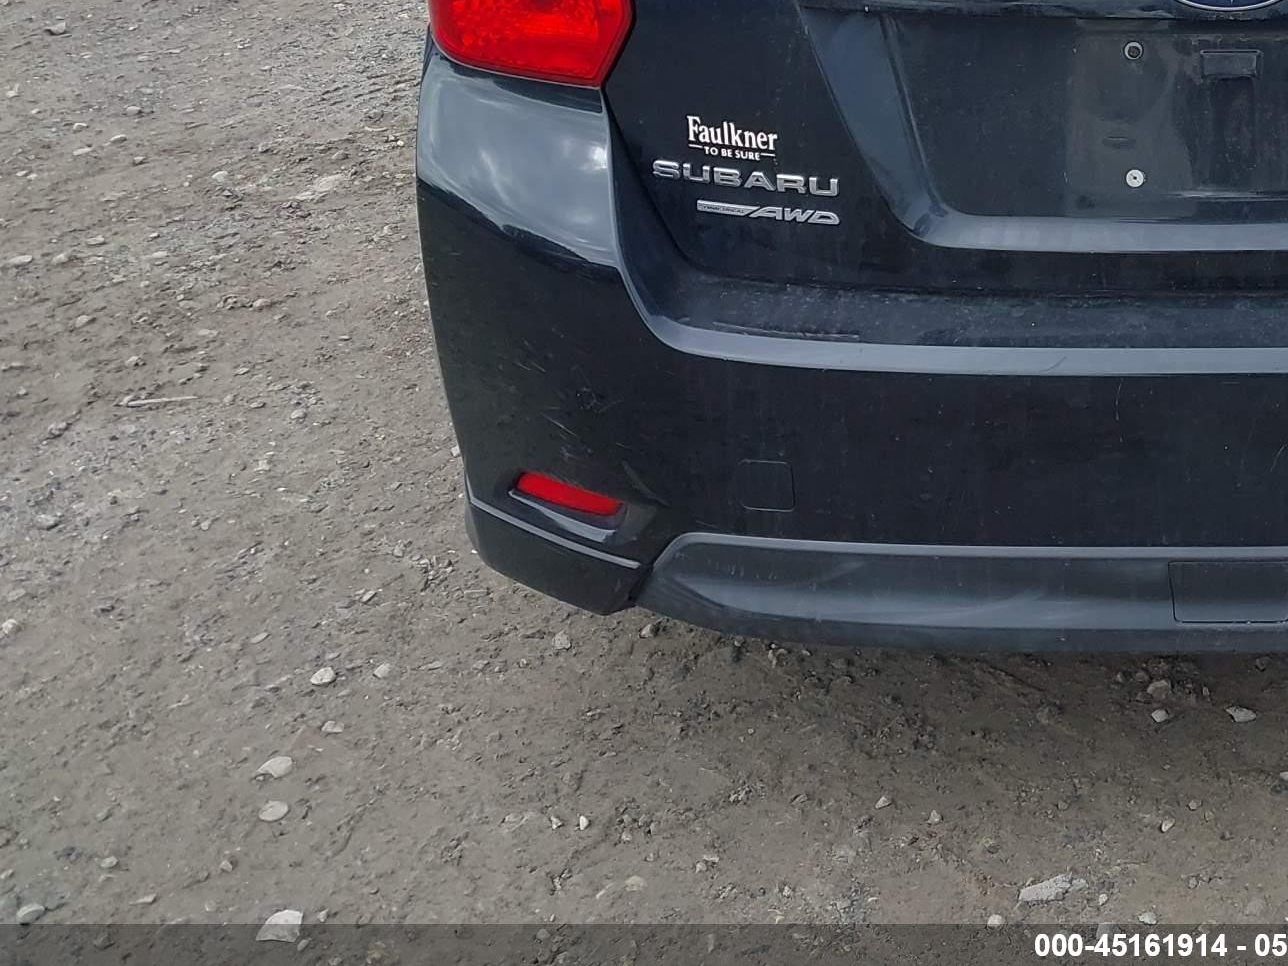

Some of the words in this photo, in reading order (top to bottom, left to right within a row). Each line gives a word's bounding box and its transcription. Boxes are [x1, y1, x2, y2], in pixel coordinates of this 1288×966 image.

[686, 115, 778, 151] Faulkner
[704, 145, 718, 156] TO
[721, 147, 733, 158] BE
[735, 149, 760, 161] SURE
[652, 159, 839, 197] SUBARU
[748, 205, 841, 226] AWD
